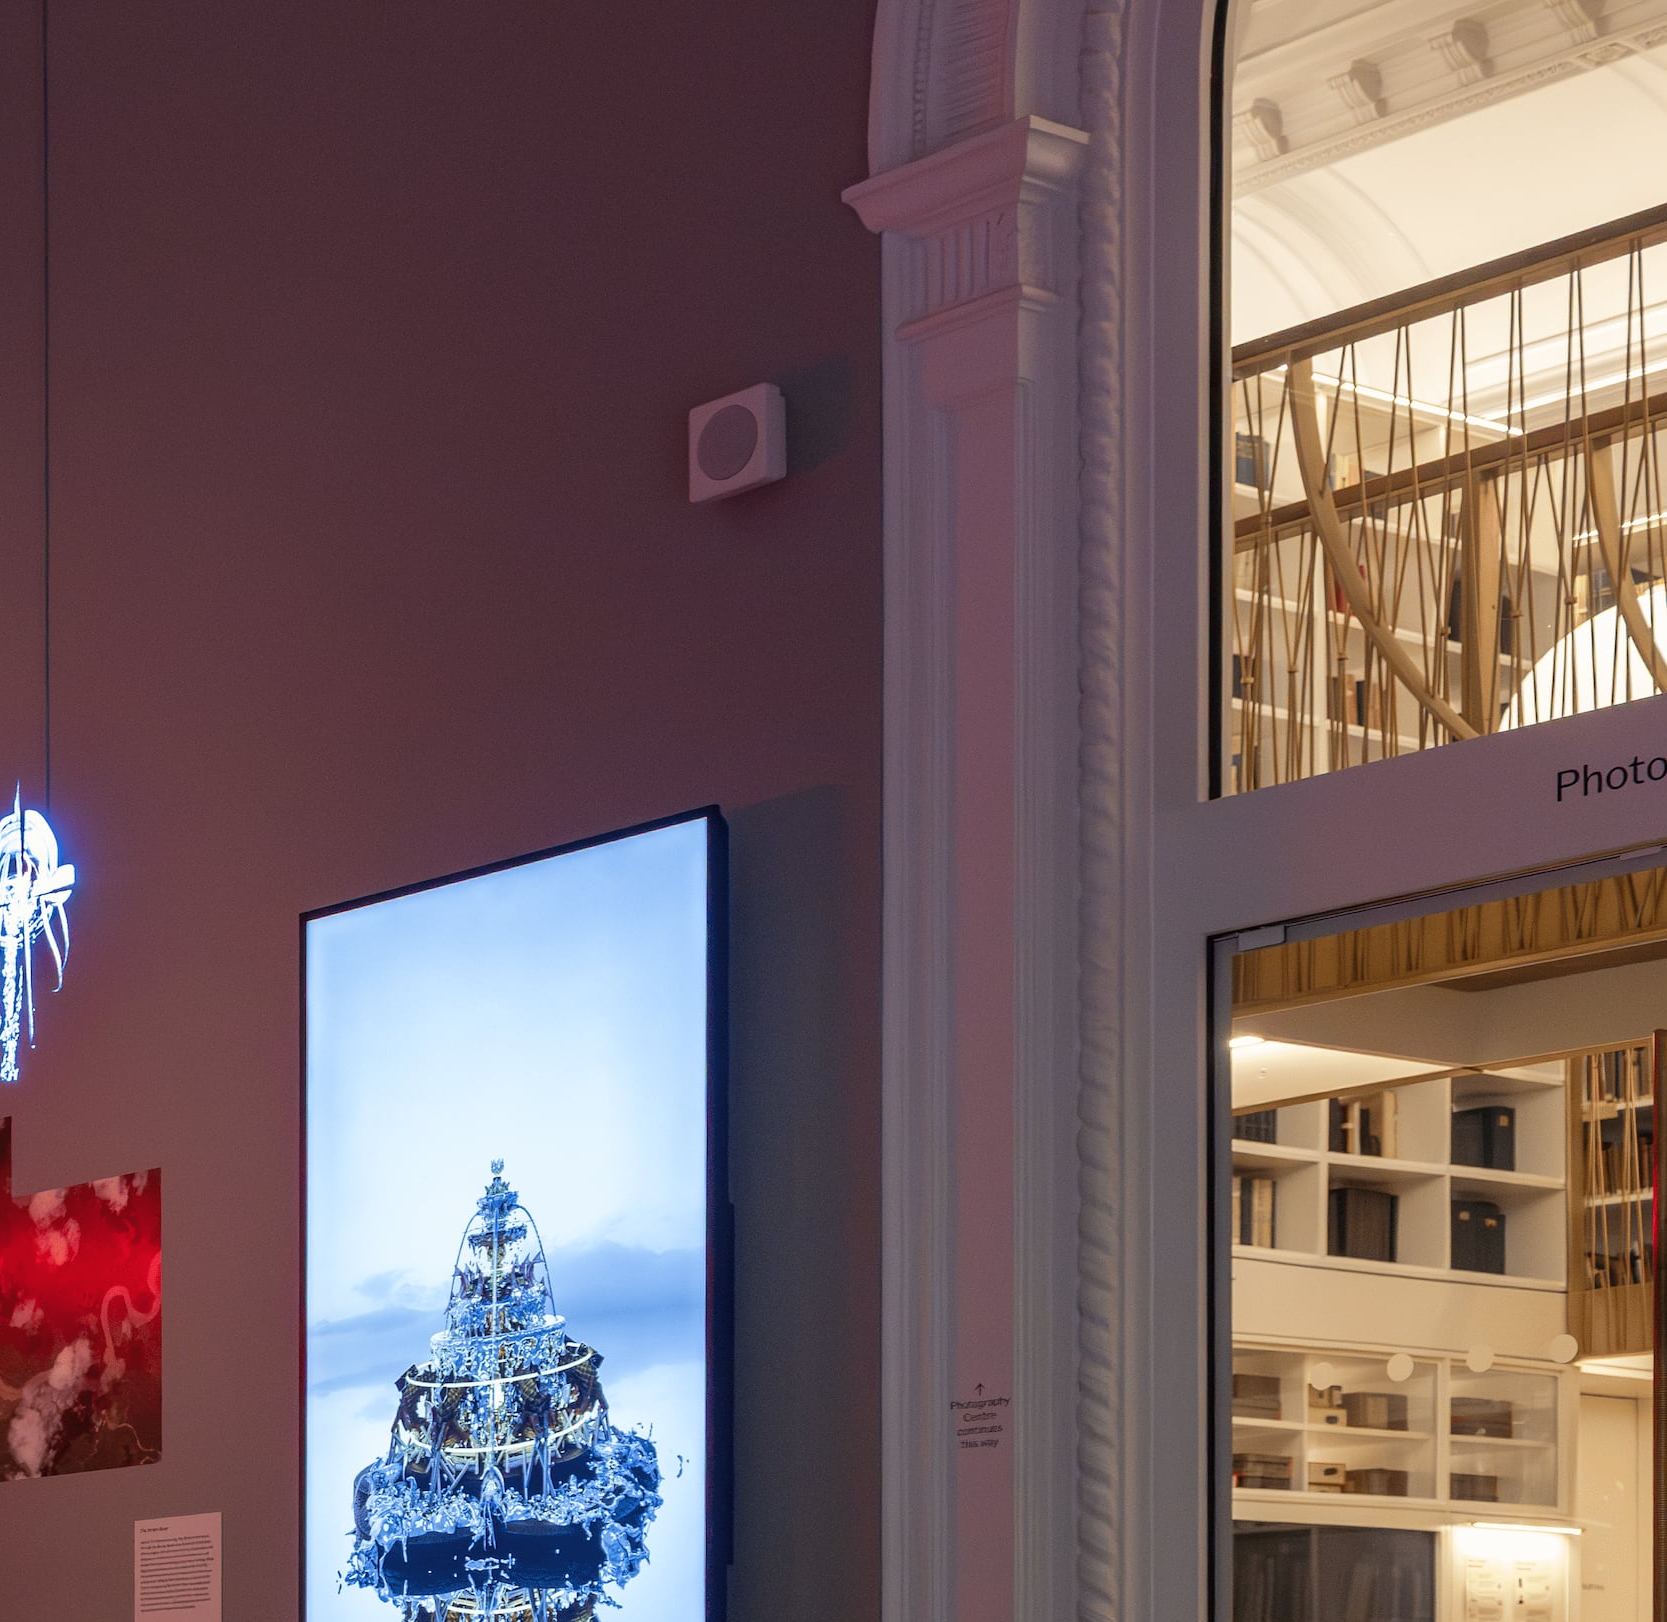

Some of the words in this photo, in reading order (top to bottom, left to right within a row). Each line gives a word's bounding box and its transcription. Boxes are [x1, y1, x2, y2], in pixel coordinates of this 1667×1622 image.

[950, 1397, 1011, 1410] Photography
[963, 1412, 997, 1422] Centre
[957, 1425, 1003, 1437] continues
